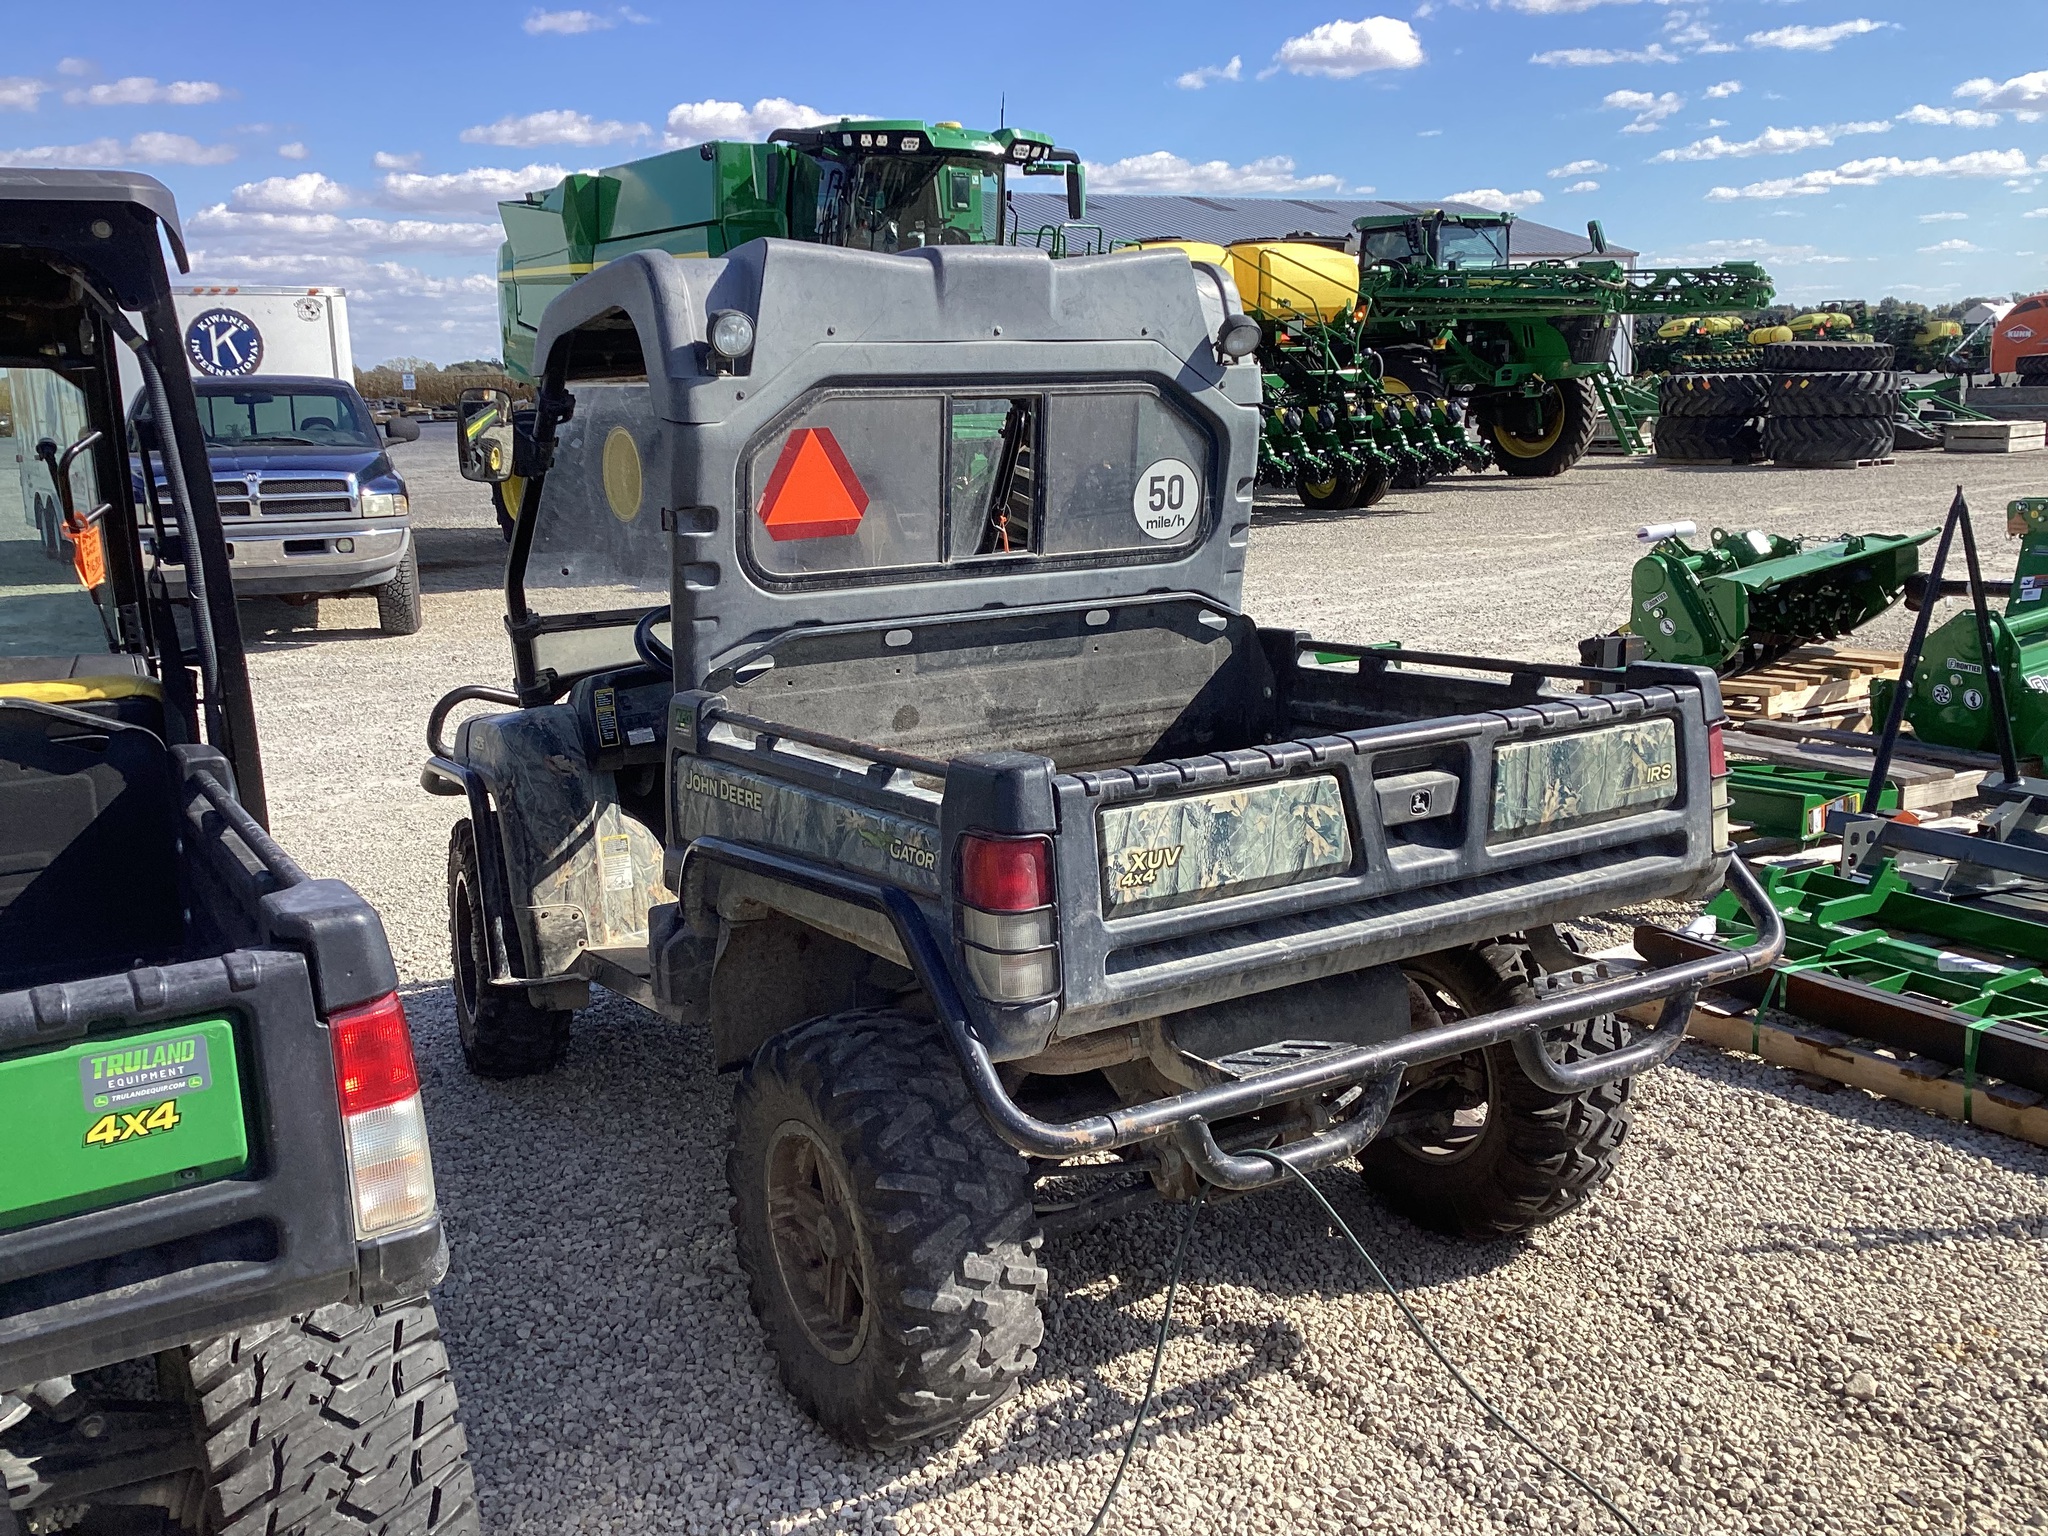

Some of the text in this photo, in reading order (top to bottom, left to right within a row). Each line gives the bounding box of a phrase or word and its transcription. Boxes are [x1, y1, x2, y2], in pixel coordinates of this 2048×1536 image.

[197, 313, 250, 332] KIWANIS
[2007, 330, 2032, 338] KUHN
[208, 324, 244, 367] K
[191, 338, 259, 376] INTERNATIONAL
[1148, 474, 1185, 512] 50
[1146, 514, 1186, 530] mile/h
[1947, 659, 1982, 674] FRONTIER
[1646, 762, 1673, 783] IRS
[685, 769, 763, 812] JOHN DEERE
[889, 838, 936, 870] GATOR
[1129, 845, 1183, 873] XUV
[1120, 868, 1157, 888] 4x4
[91, 1039, 196, 1080] TRULAND
[108, 1066, 185, 1088] EQUIPMENT
[111, 1081, 186, 1102] TRULANDEQUIP.COM
